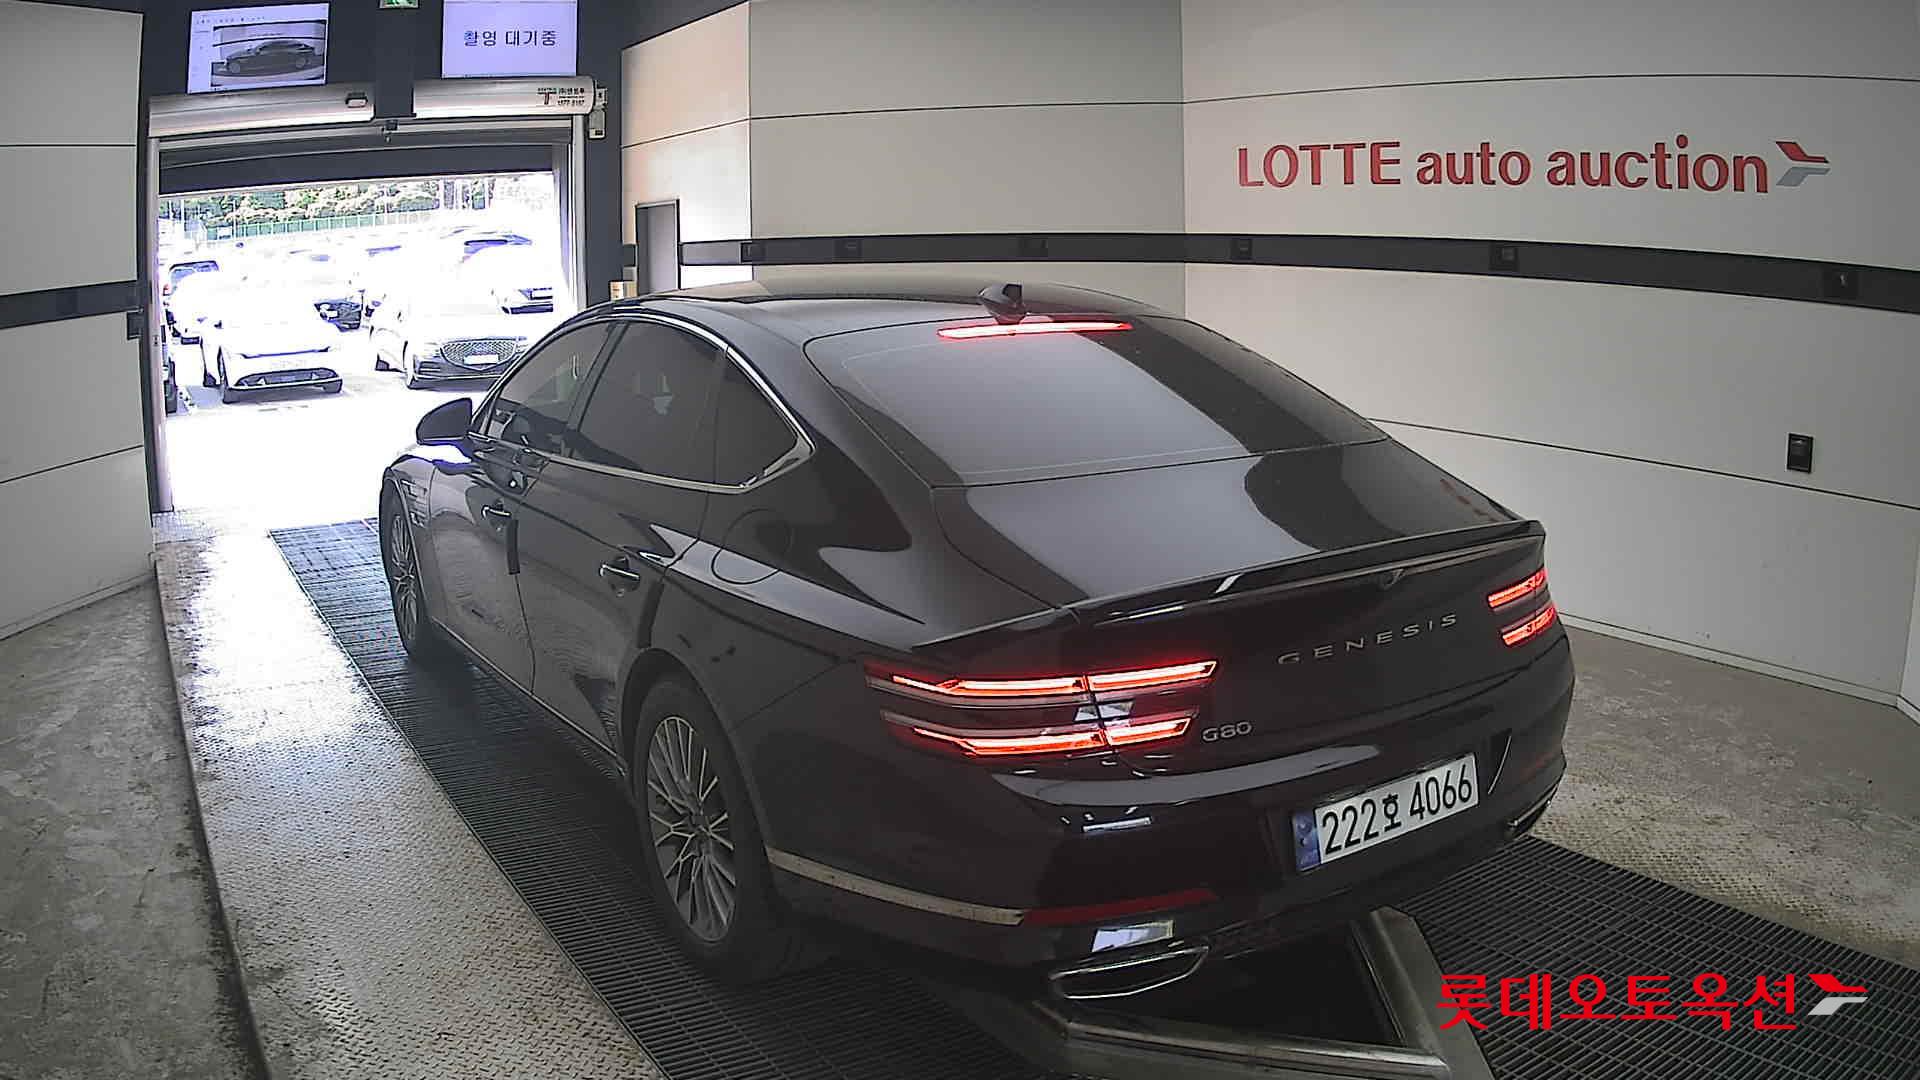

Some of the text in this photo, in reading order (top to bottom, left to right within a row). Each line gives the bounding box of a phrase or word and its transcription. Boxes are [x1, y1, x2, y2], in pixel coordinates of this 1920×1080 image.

[464, 30, 556, 47] 촬영 대기중
[1237, 134, 1769, 194] LOTTE auto auction
[1277, 613, 1457, 665] GENESIS
[1202, 721, 1252, 743] G80
[1321, 764, 1473, 855] 222호 4066
